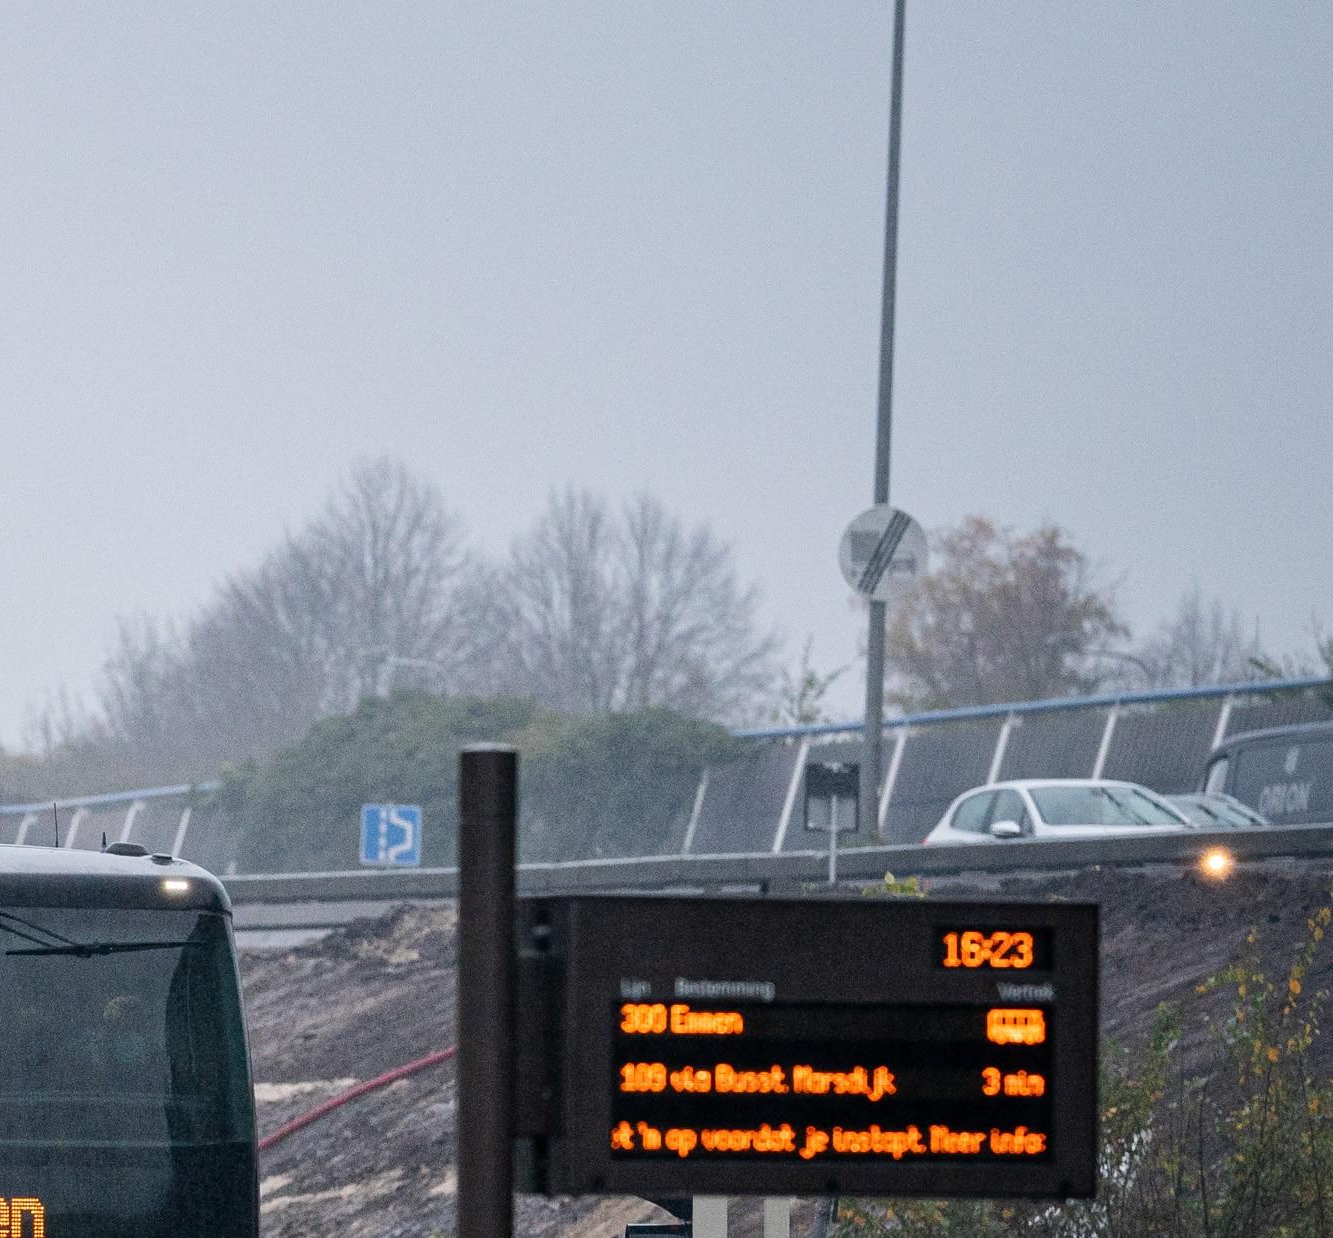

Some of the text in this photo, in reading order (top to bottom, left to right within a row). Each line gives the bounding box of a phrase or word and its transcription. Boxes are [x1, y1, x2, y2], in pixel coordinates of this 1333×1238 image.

[943, 931, 1033, 968] 16:23
[674, 976, 776, 1003] Bestemming
[620, 1003, 744, 1035] 300 Emmen
[669, 1065, 712, 1093] via
[982, 1066, 1001, 1097] 3
[1004, 1069, 1046, 1097] min
[664, 1128, 698, 1158] op
[799, 1125, 830, 1160] je
